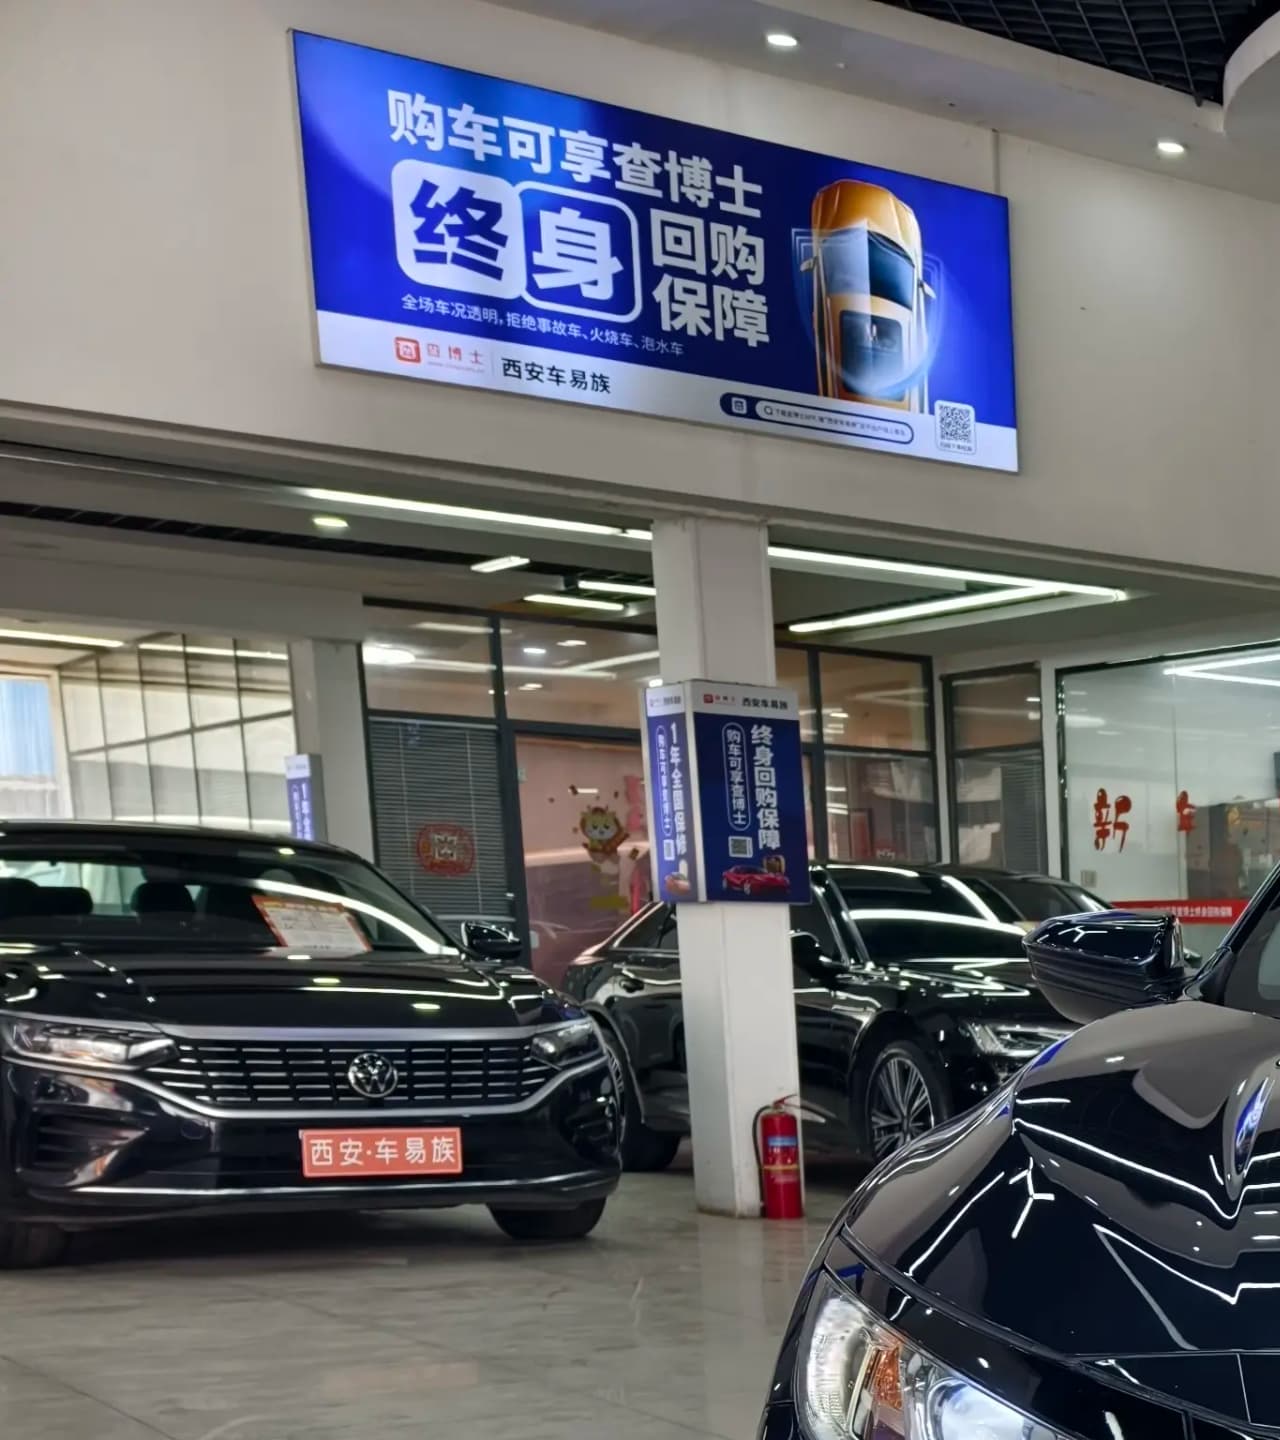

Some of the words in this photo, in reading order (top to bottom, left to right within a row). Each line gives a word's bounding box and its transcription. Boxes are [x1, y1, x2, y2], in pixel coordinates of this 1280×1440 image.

[387, 88, 763, 219] 购车可享查博士
[408, 178, 624, 302] 终身
[651, 208, 767, 286] 回购
[652, 275, 771, 349] 保障
[501, 357, 612, 394] 西安车易族
[726, 730, 747, 825] 购车可享查博士
[750, 724, 781, 850] 终身回购保障
[309, 1136, 456, 1166] 西安·车易族
